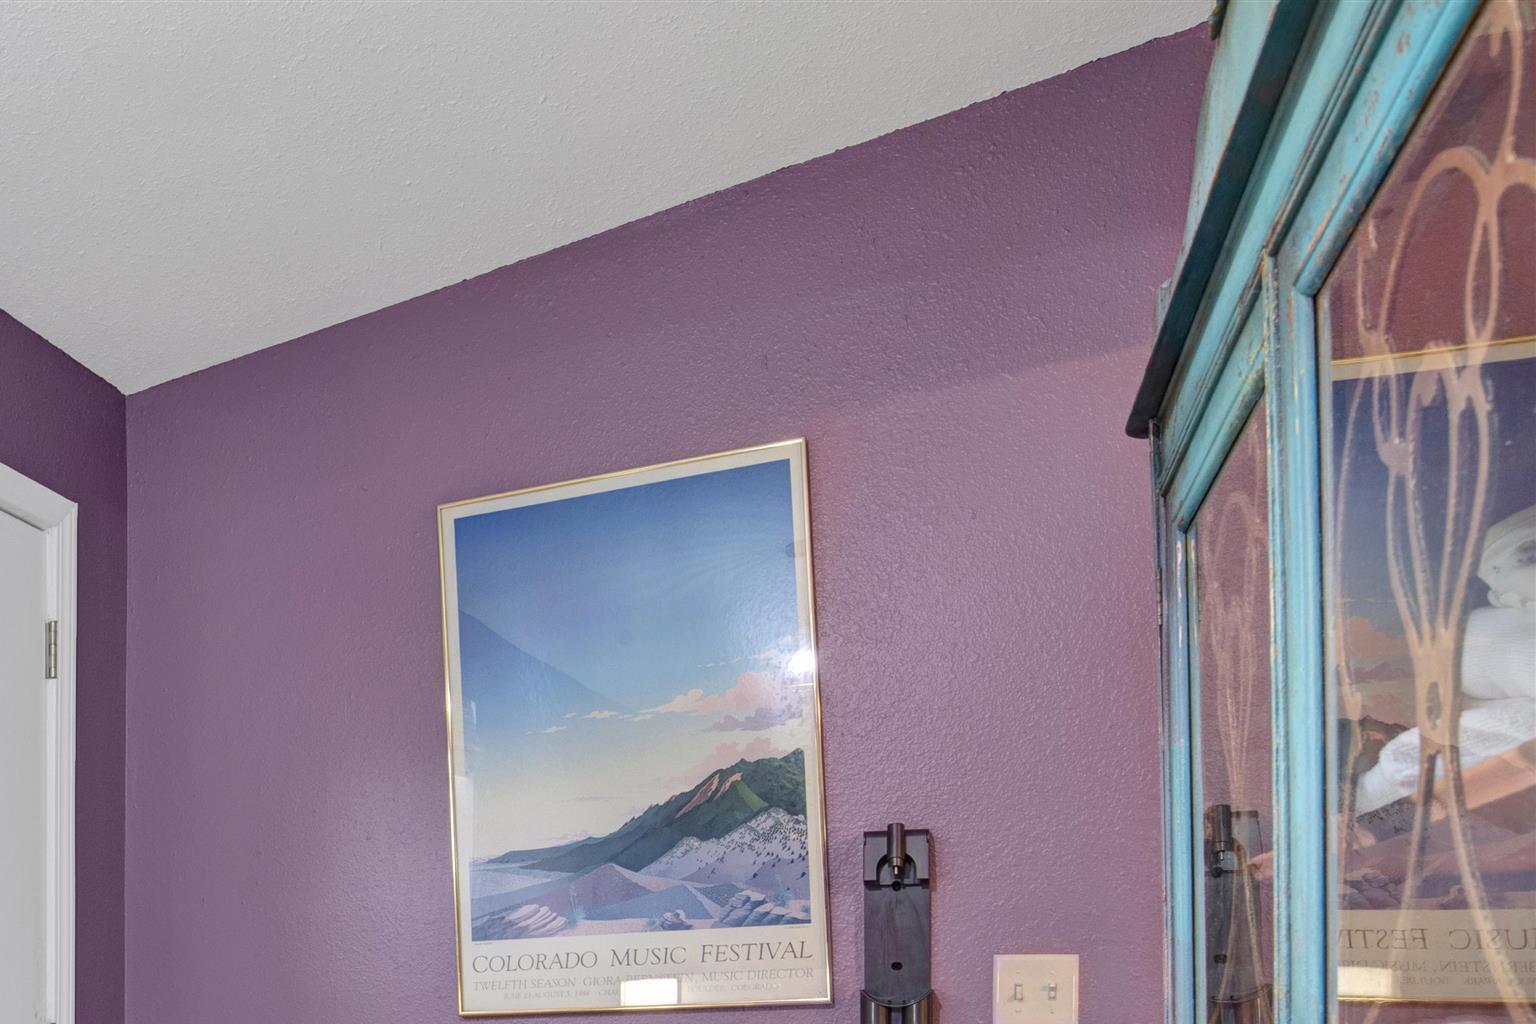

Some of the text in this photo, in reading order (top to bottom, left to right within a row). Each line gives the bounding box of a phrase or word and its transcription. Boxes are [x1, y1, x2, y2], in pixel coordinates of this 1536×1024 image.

[472, 940, 814, 974] COLORADO MUSIC FESTIVAL
[472, 979, 528, 993] TWELFTH
[530, 977, 577, 989] SEASON
[583, 975, 622, 987] GIORA
[702, 970, 744, 982] MUSIC
[746, 967, 814, 981] DIRECTOR
